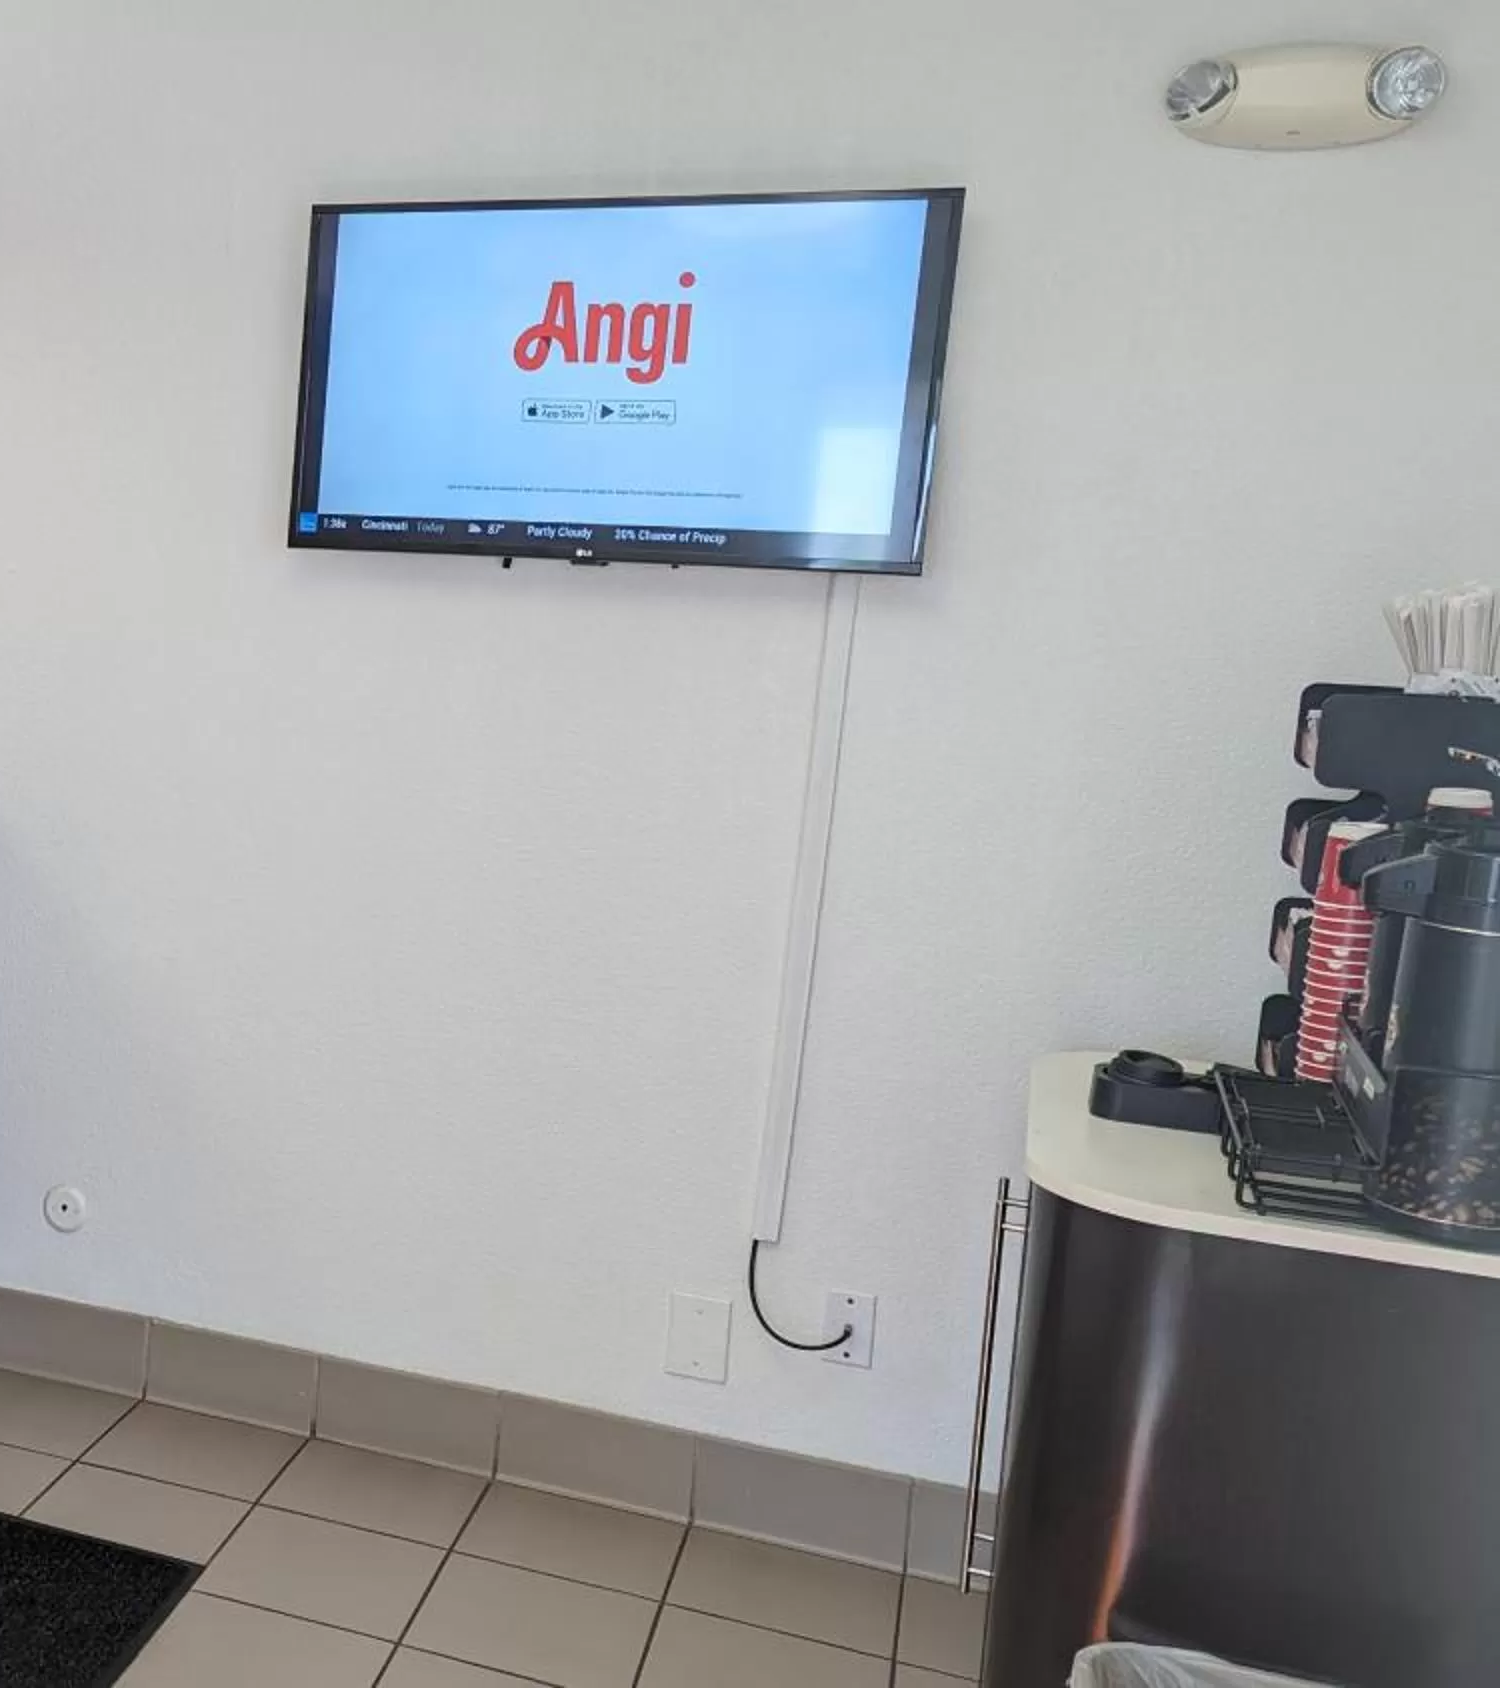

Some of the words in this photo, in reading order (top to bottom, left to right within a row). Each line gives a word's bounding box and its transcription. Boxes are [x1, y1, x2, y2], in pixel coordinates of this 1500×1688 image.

[514, 272, 695, 384] Angi
[416, 521, 445, 535] Today
[527, 524, 556, 539] Partly
[557, 526, 592, 541] Cloudy
[679, 530, 691, 542] of
